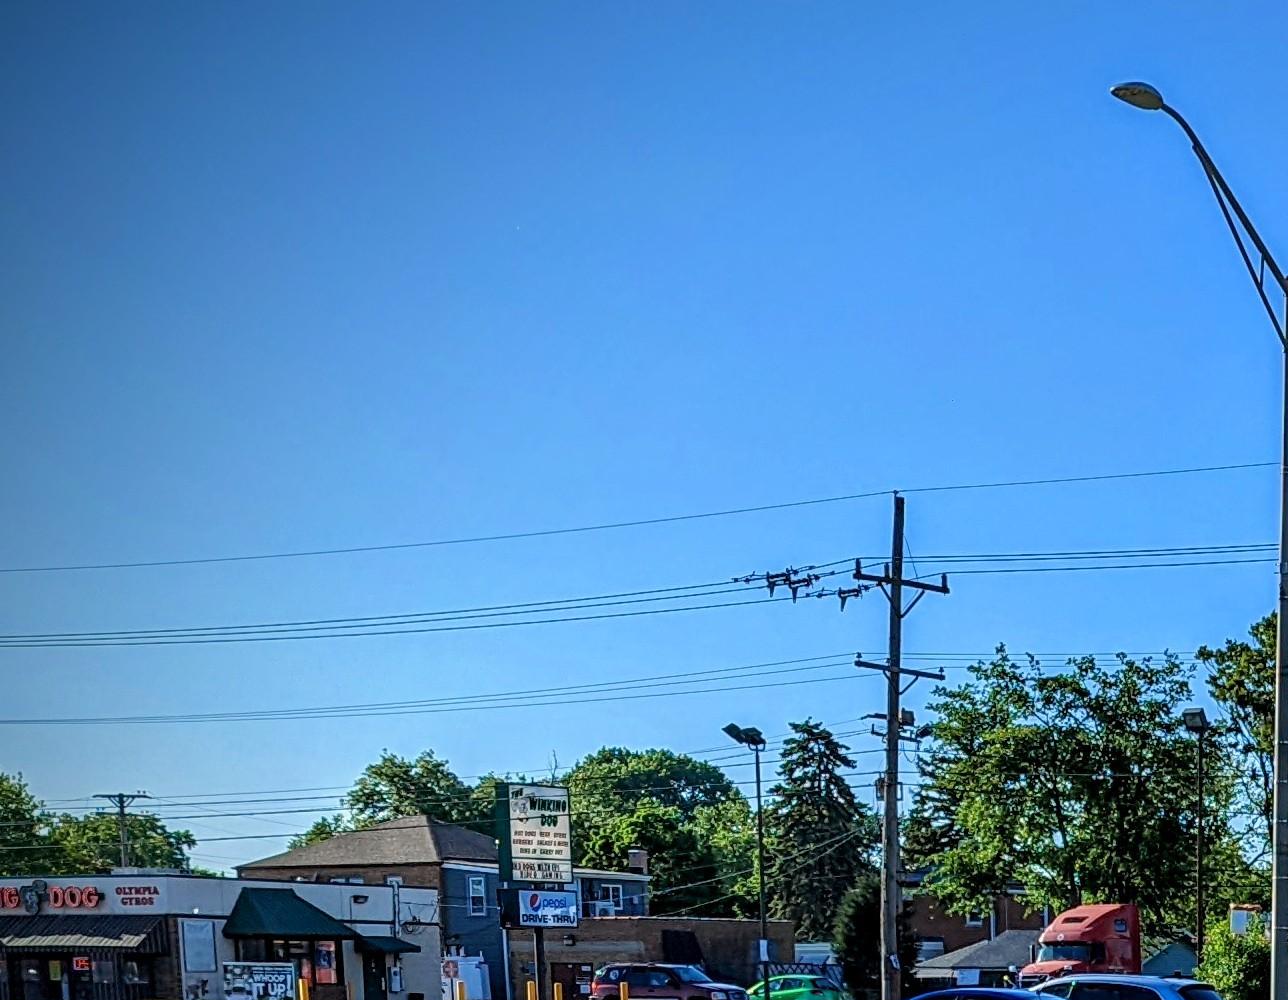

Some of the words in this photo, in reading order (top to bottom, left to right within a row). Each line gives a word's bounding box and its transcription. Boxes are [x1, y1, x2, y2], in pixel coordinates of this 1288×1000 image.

[115, 886, 160, 896] OLYMPIA
[49, 886, 99, 908] DOG
[542, 897, 567, 911] pepsi
[521, 913, 576, 924] DRIVE-THRU
[253, 973, 286, 983] WHOOP
